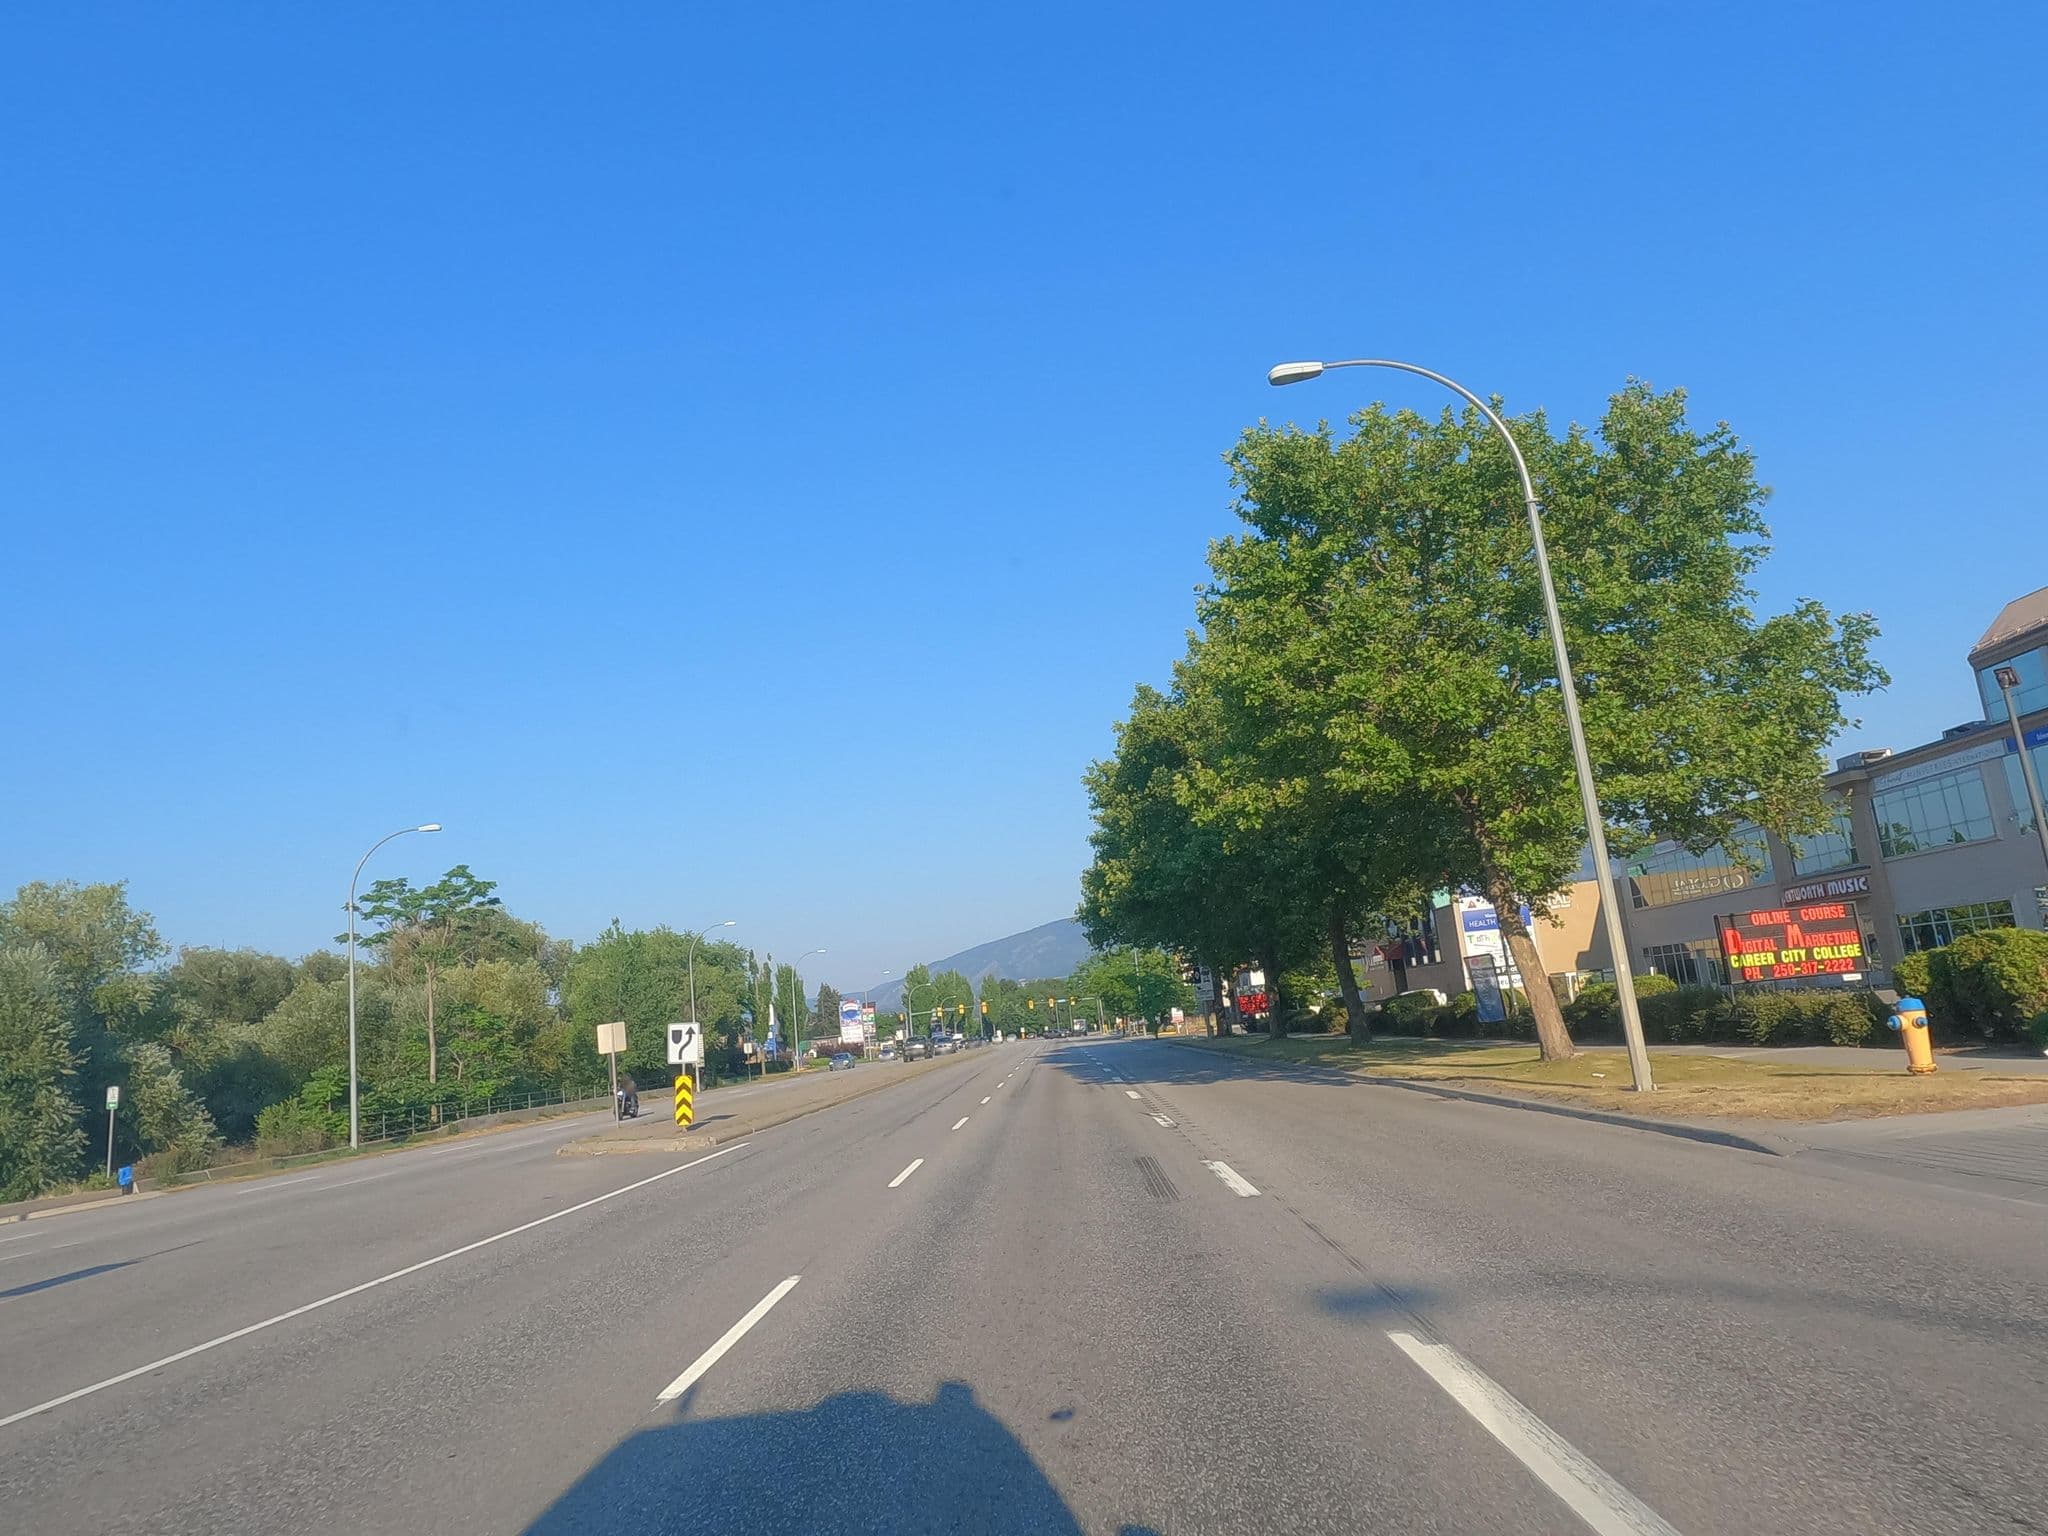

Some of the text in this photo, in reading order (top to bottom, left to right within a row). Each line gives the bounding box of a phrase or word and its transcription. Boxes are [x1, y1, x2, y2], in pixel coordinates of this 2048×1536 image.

[1827, 877, 1868, 896] MUSIC
[1468, 918, 1496, 928] HEALTH
[1751, 905, 1846, 926] ONLINE COURSE
[1730, 943, 1862, 968] CAREER CITY COLLEGE
[1744, 958, 1855, 980] PH. 250-317-2222
